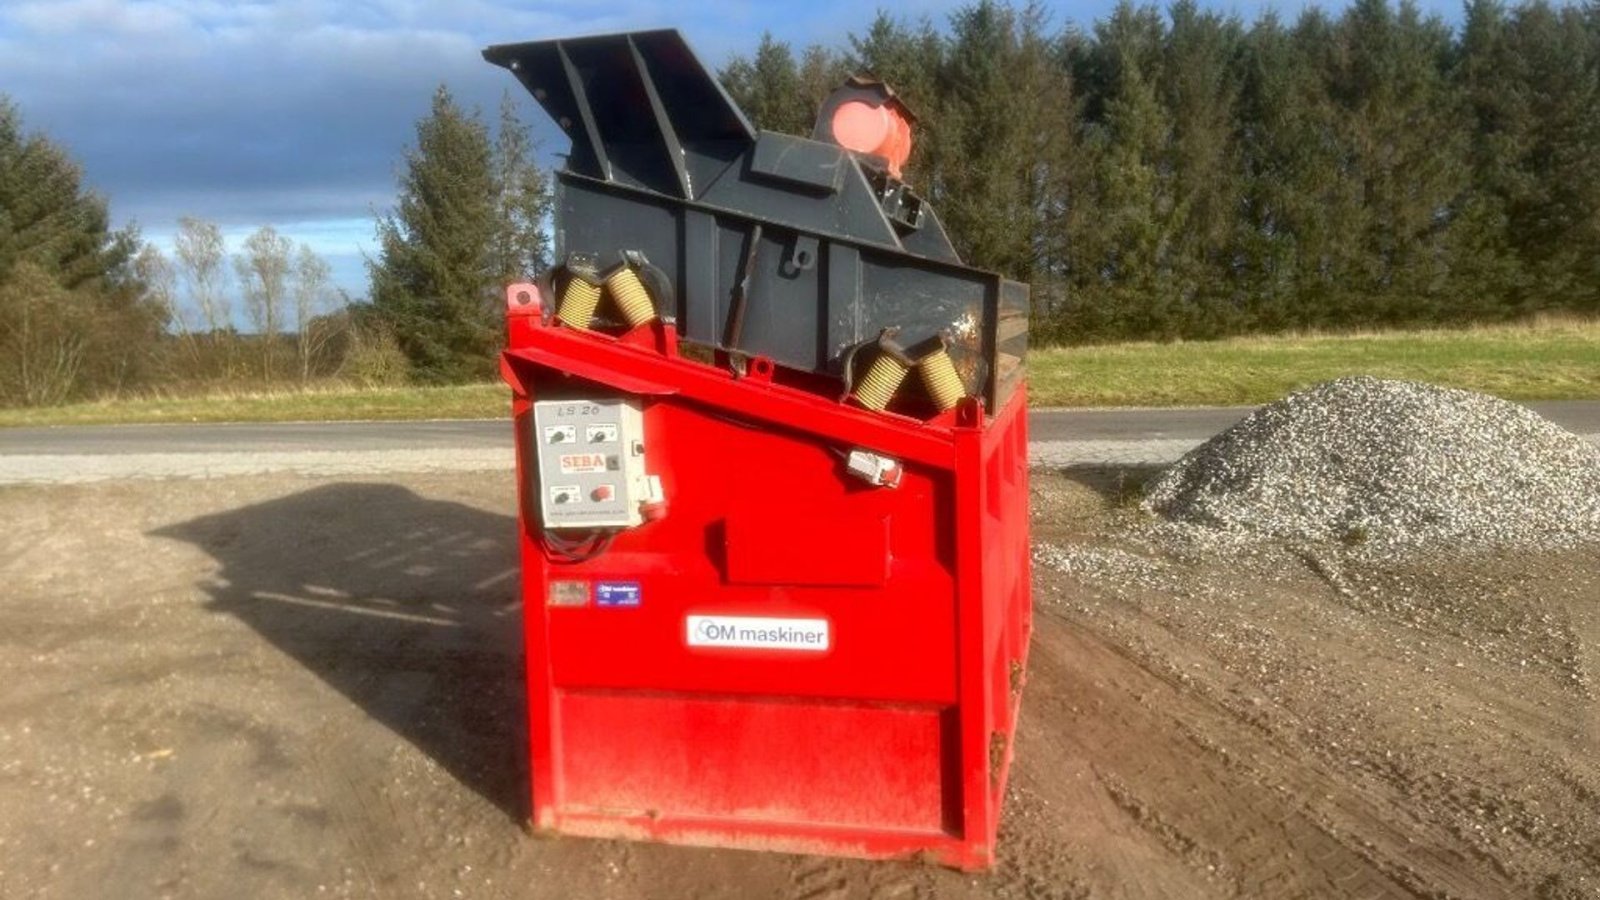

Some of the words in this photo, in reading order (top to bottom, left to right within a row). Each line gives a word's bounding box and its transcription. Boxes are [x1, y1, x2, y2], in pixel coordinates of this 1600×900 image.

[562, 456, 603, 468] SEBA
[706, 624, 736, 641] OM
[740, 626, 824, 643] maskiner
